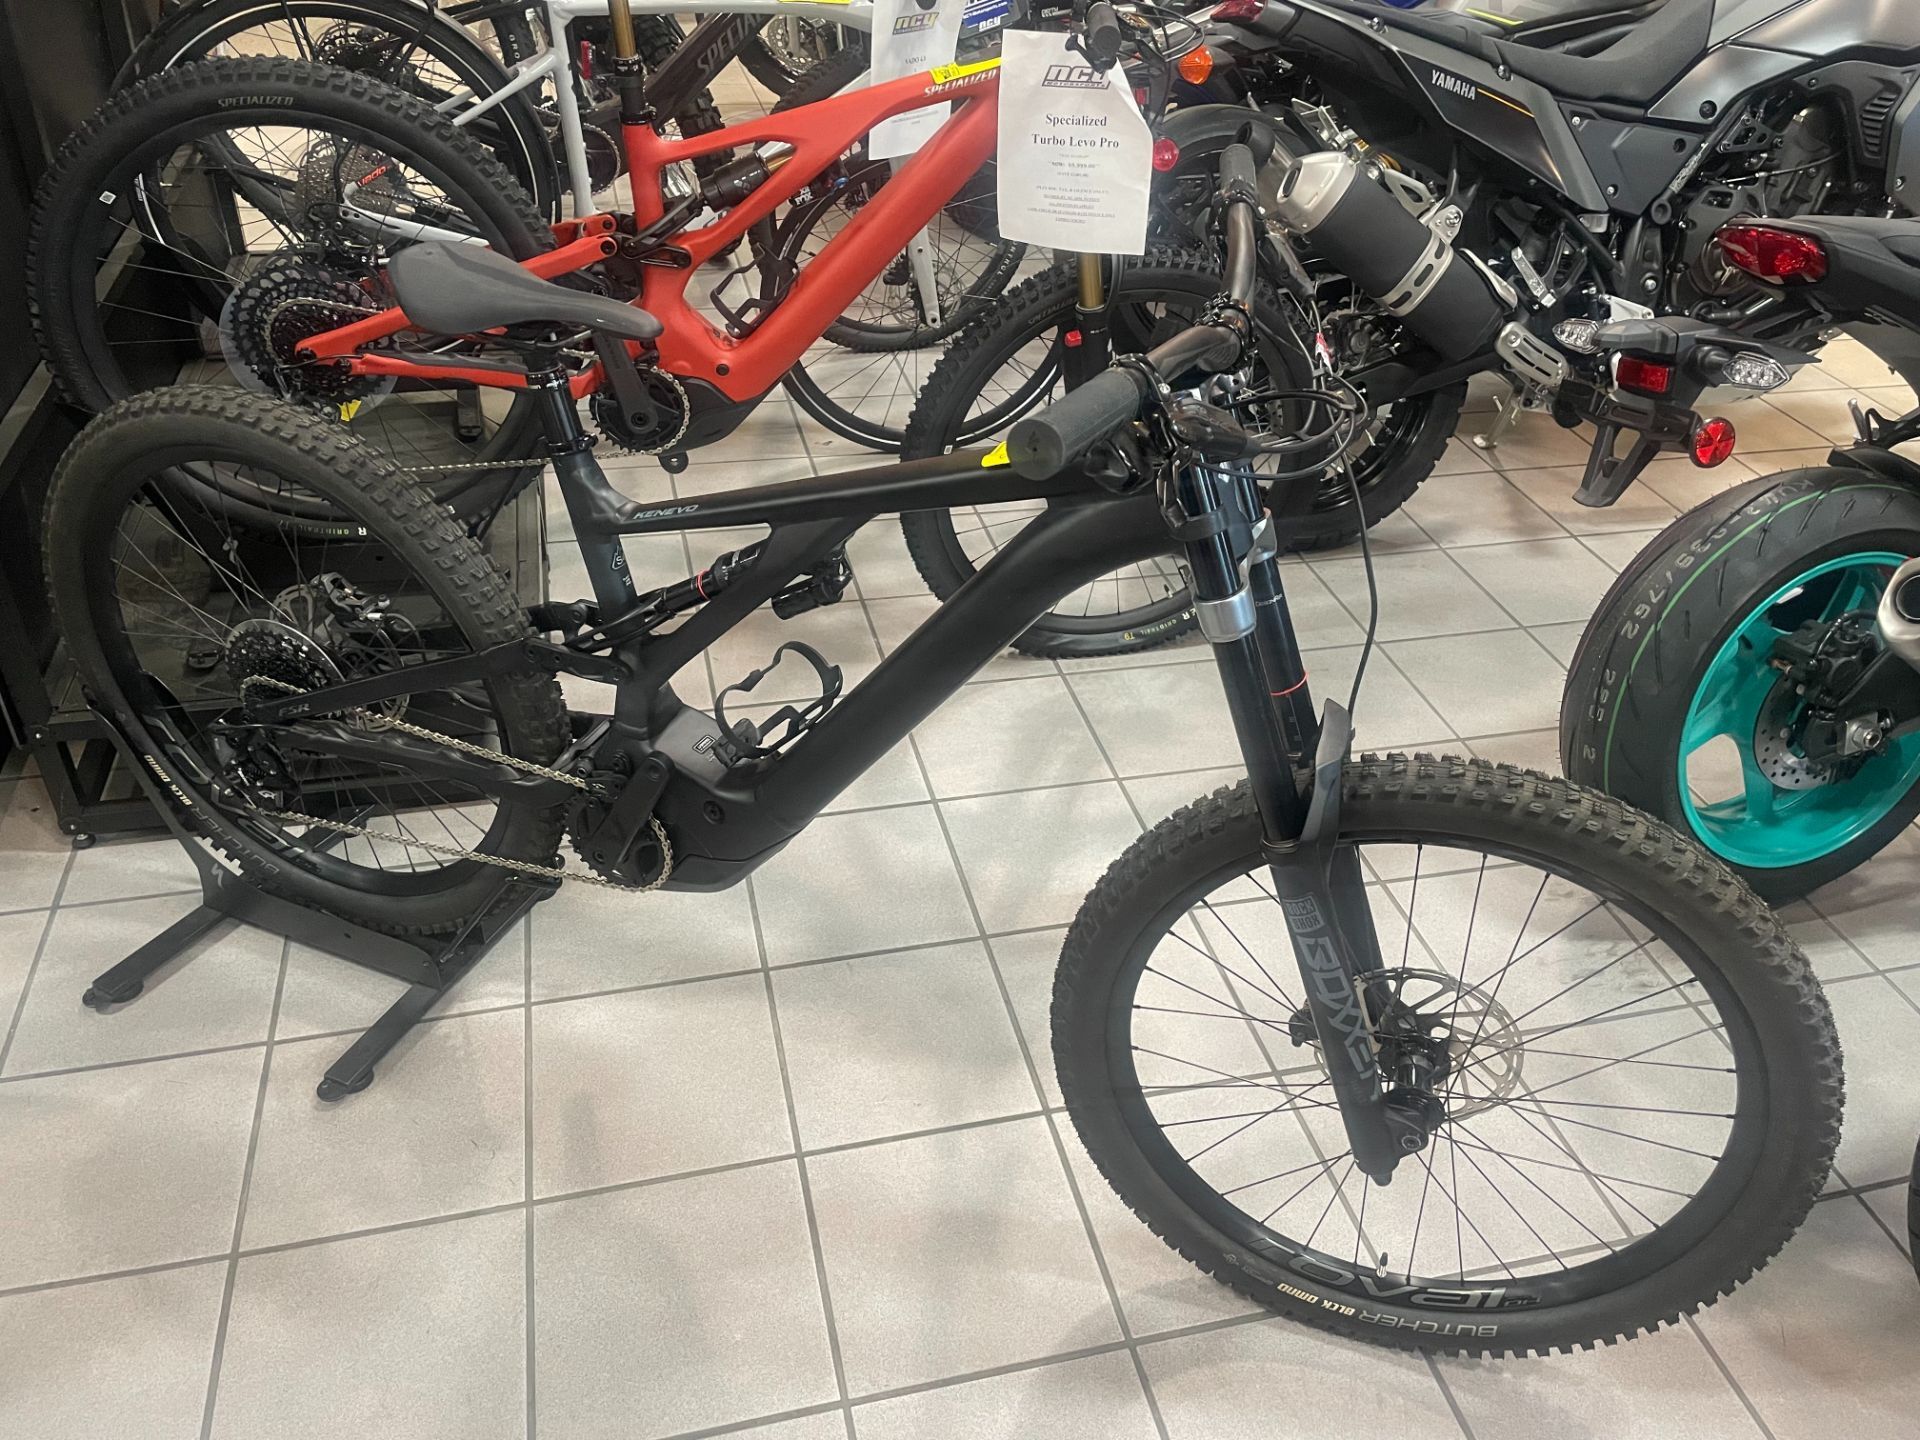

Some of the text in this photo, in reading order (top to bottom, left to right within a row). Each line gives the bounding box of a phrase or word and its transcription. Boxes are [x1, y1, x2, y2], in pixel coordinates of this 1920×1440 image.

[924, 70, 997, 98] SPECIALIZED
[1431, 69, 1476, 100] YAMAHA
[217, 95, 295, 108] SPECIALIZED
[1045, 113, 1107, 127] Specialized
[1031, 133, 1120, 148] Turbo Levo Pro
[632, 504, 699, 520] KENEVO
[278, 702, 311, 718] FSR
[1321, 1298, 1356, 1316] BLCK
[1358, 1311, 1498, 1338] BUTCHER
